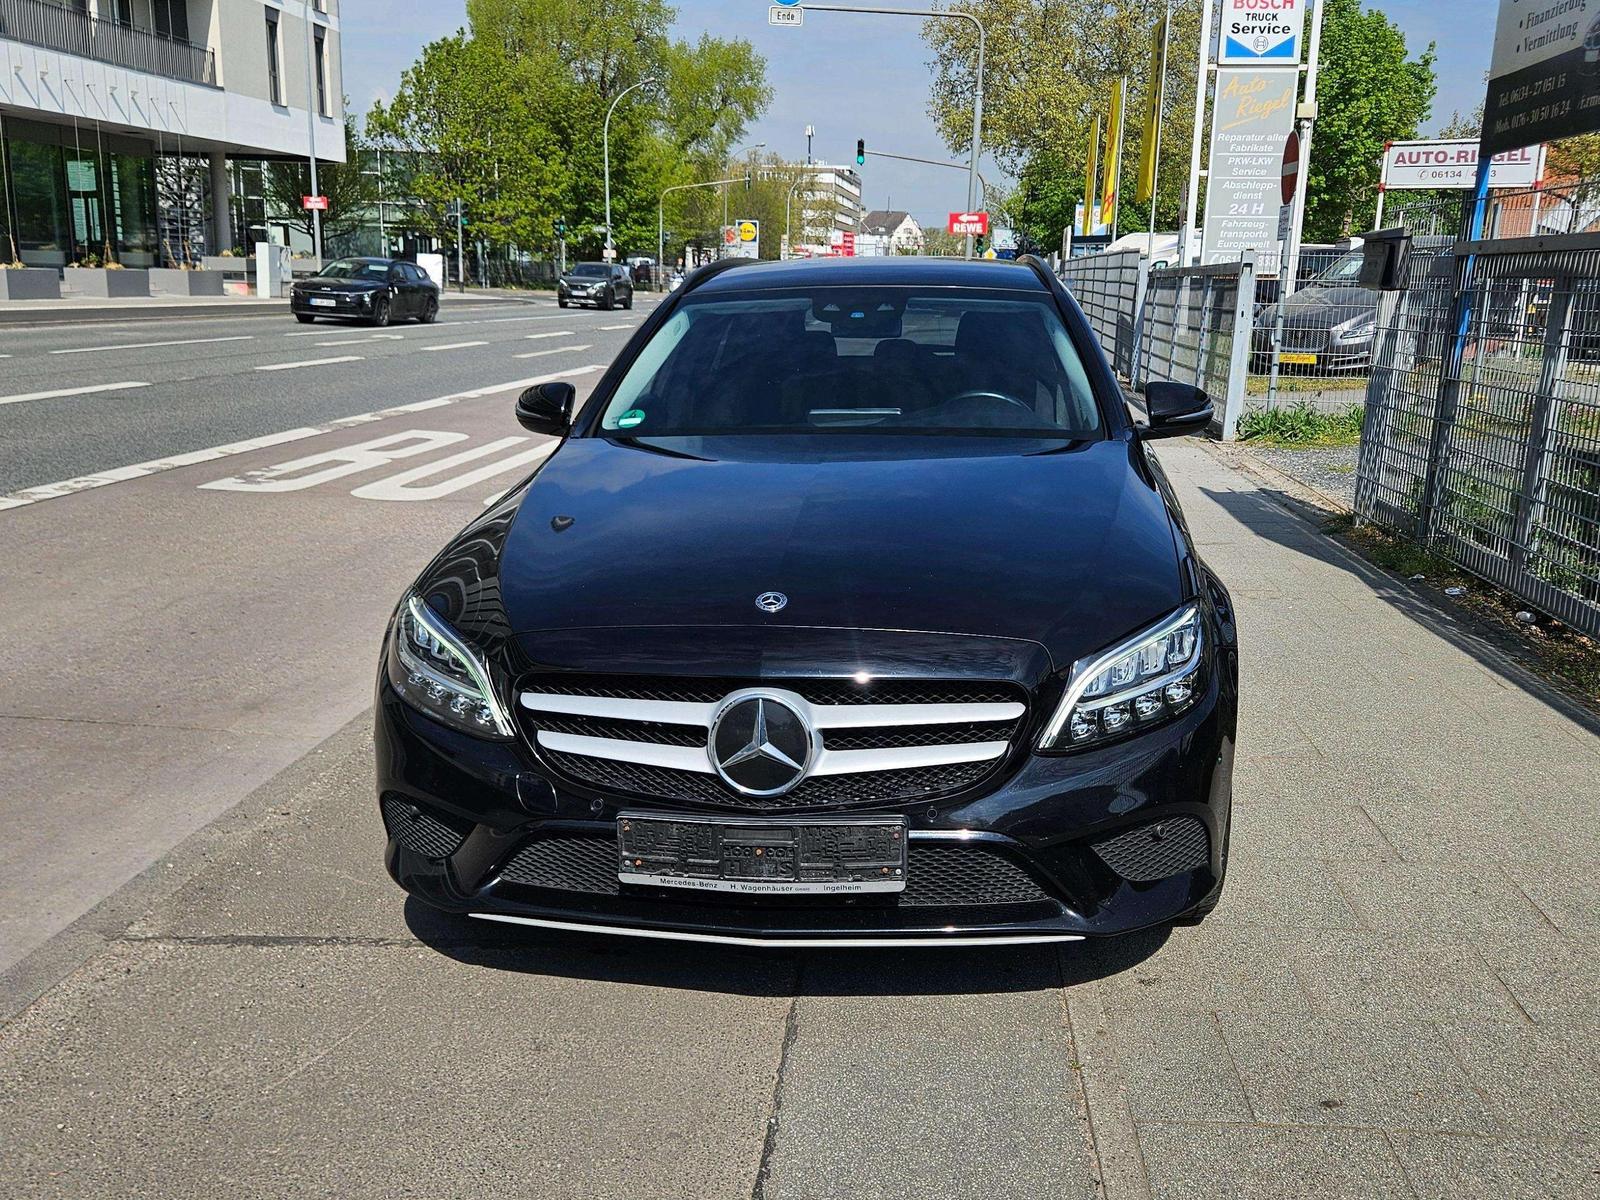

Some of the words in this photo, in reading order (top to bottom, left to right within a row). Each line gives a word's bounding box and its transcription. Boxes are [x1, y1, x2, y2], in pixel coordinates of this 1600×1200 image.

[1233, 0, 1294, 9] BOSCH
[777, 11, 795, 20] Ende
[1245, 12, 1278, 21] TRUCK
[1526, 0, 1586, 29] Finanzierung
[1231, 23, 1290, 34] Service
[1524, 22, 1578, 52] Vermittlung
[1223, 75, 1272, 98] Auto
[1236, 87, 1292, 119] Riegel
[1217, 133, 1266, 143] Reparatur
[1230, 144, 1274, 152] Fabrikate
[1227, 157, 1274, 165] PKW-LKW
[1394, 148, 1531, 165] AUTO-RIGEL
[1232, 168, 1267, 176] Service
[1431, 170, 1462, 179] 06134
[1222, 181, 1277, 191] Abschlepp-
[1233, 191, 1263, 200] dienst
[1229, 203, 1248, 215] 24
[1251, 203, 1265, 215] H
[953, 223, 983, 233] REWE
[1221, 220, 1269, 230] Fahrzeug-
[1220, 230, 1268, 239] transporte
[1217, 240, 1270, 249] Europaweit
[660, 878, 718, 888] Mercedes-Benz
[740, 884, 793, 892] Wagenhäuser
